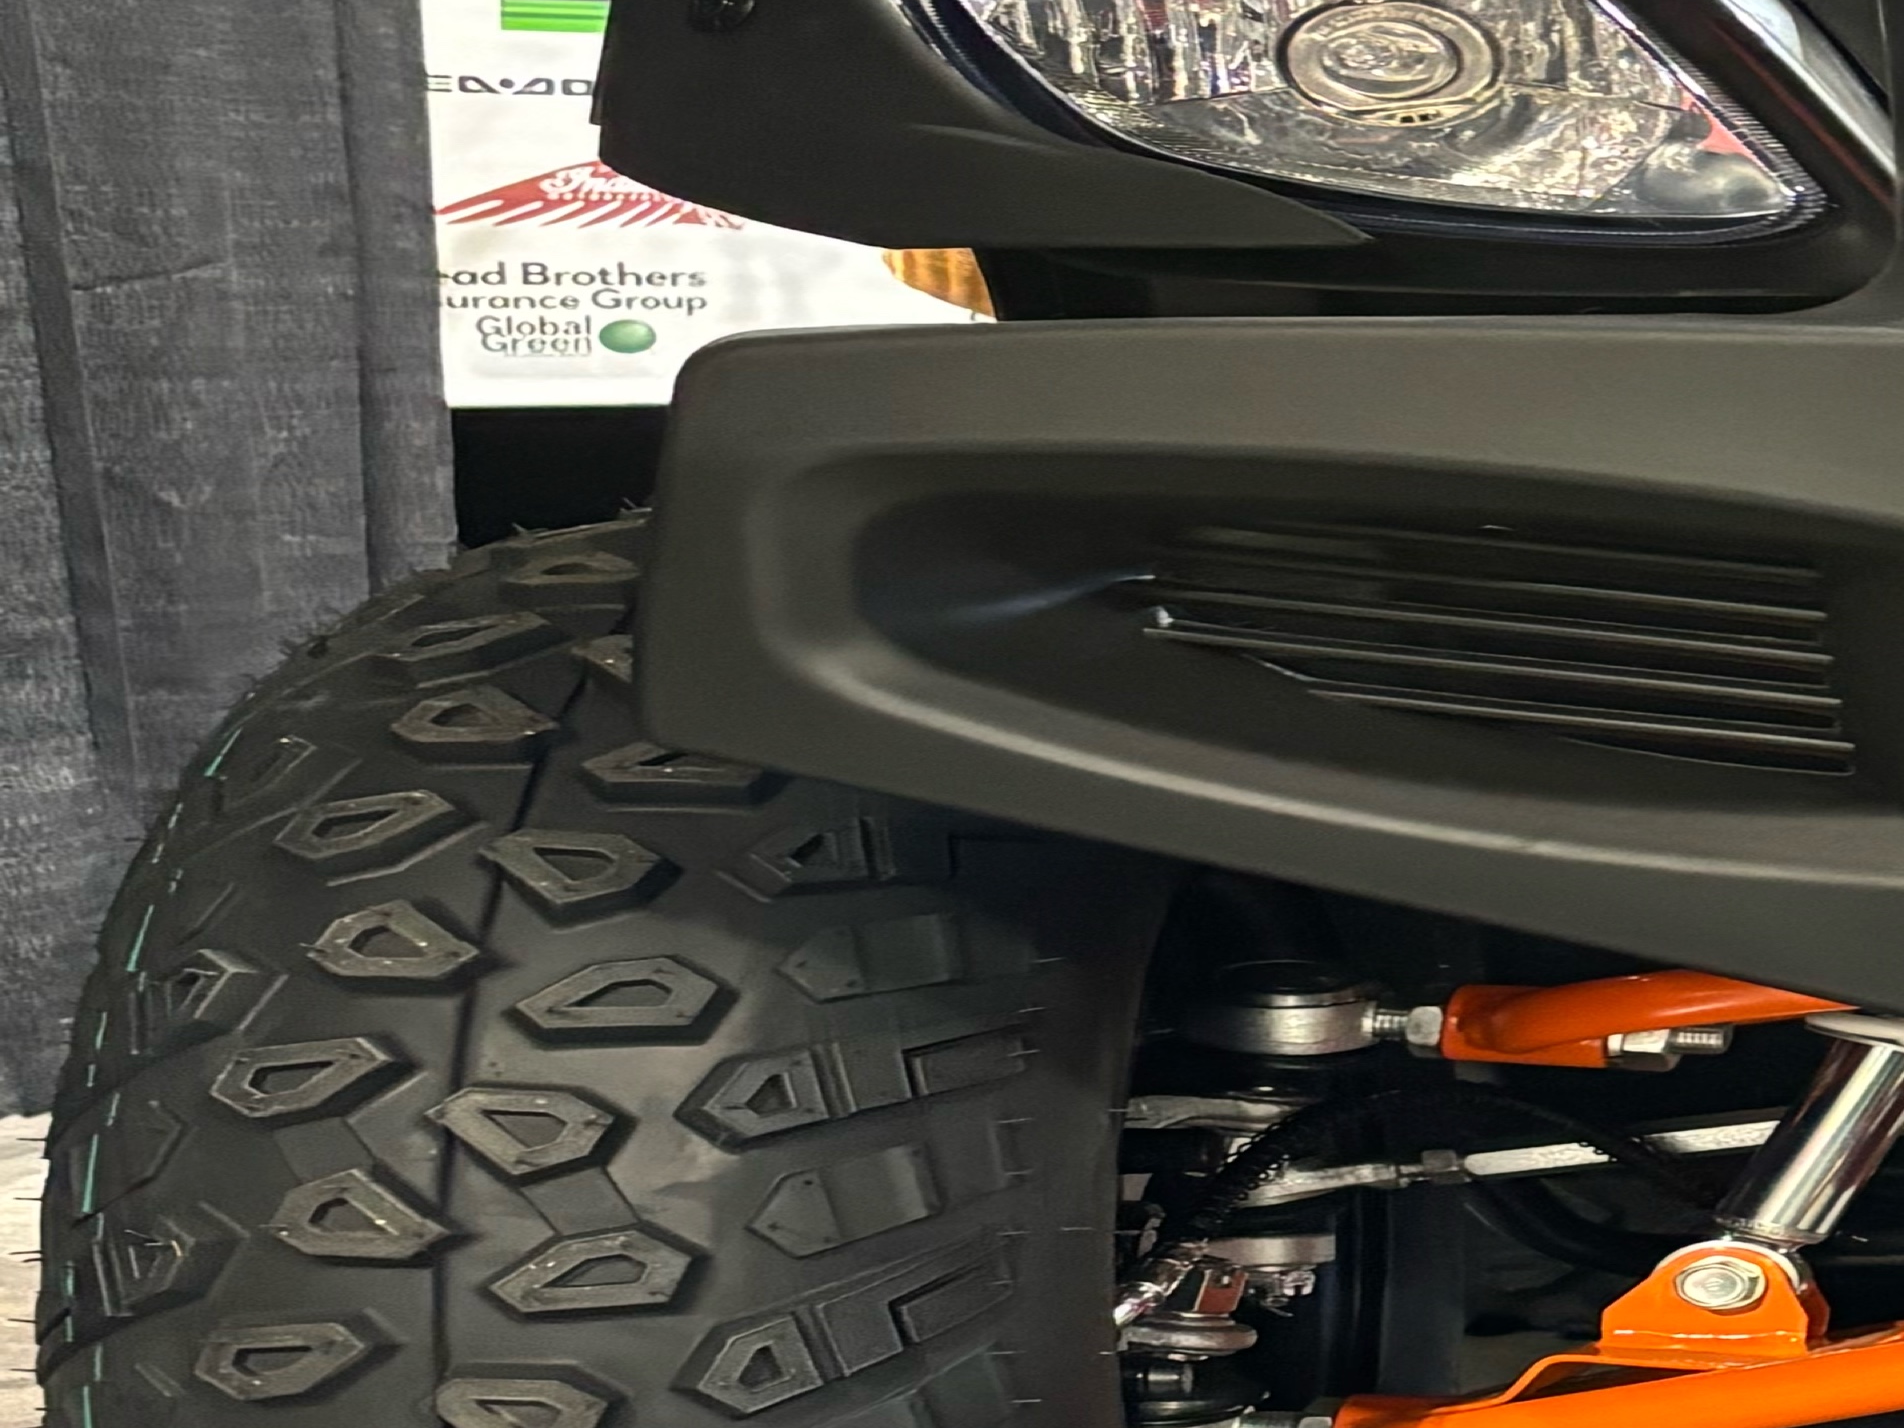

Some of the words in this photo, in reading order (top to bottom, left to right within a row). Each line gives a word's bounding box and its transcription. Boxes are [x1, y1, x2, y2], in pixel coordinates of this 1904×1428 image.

[521, 261, 708, 287] Brothers
[591, 288, 708, 316] Group
[476, 315, 592, 337] Global
[481, 333, 593, 355] Green
